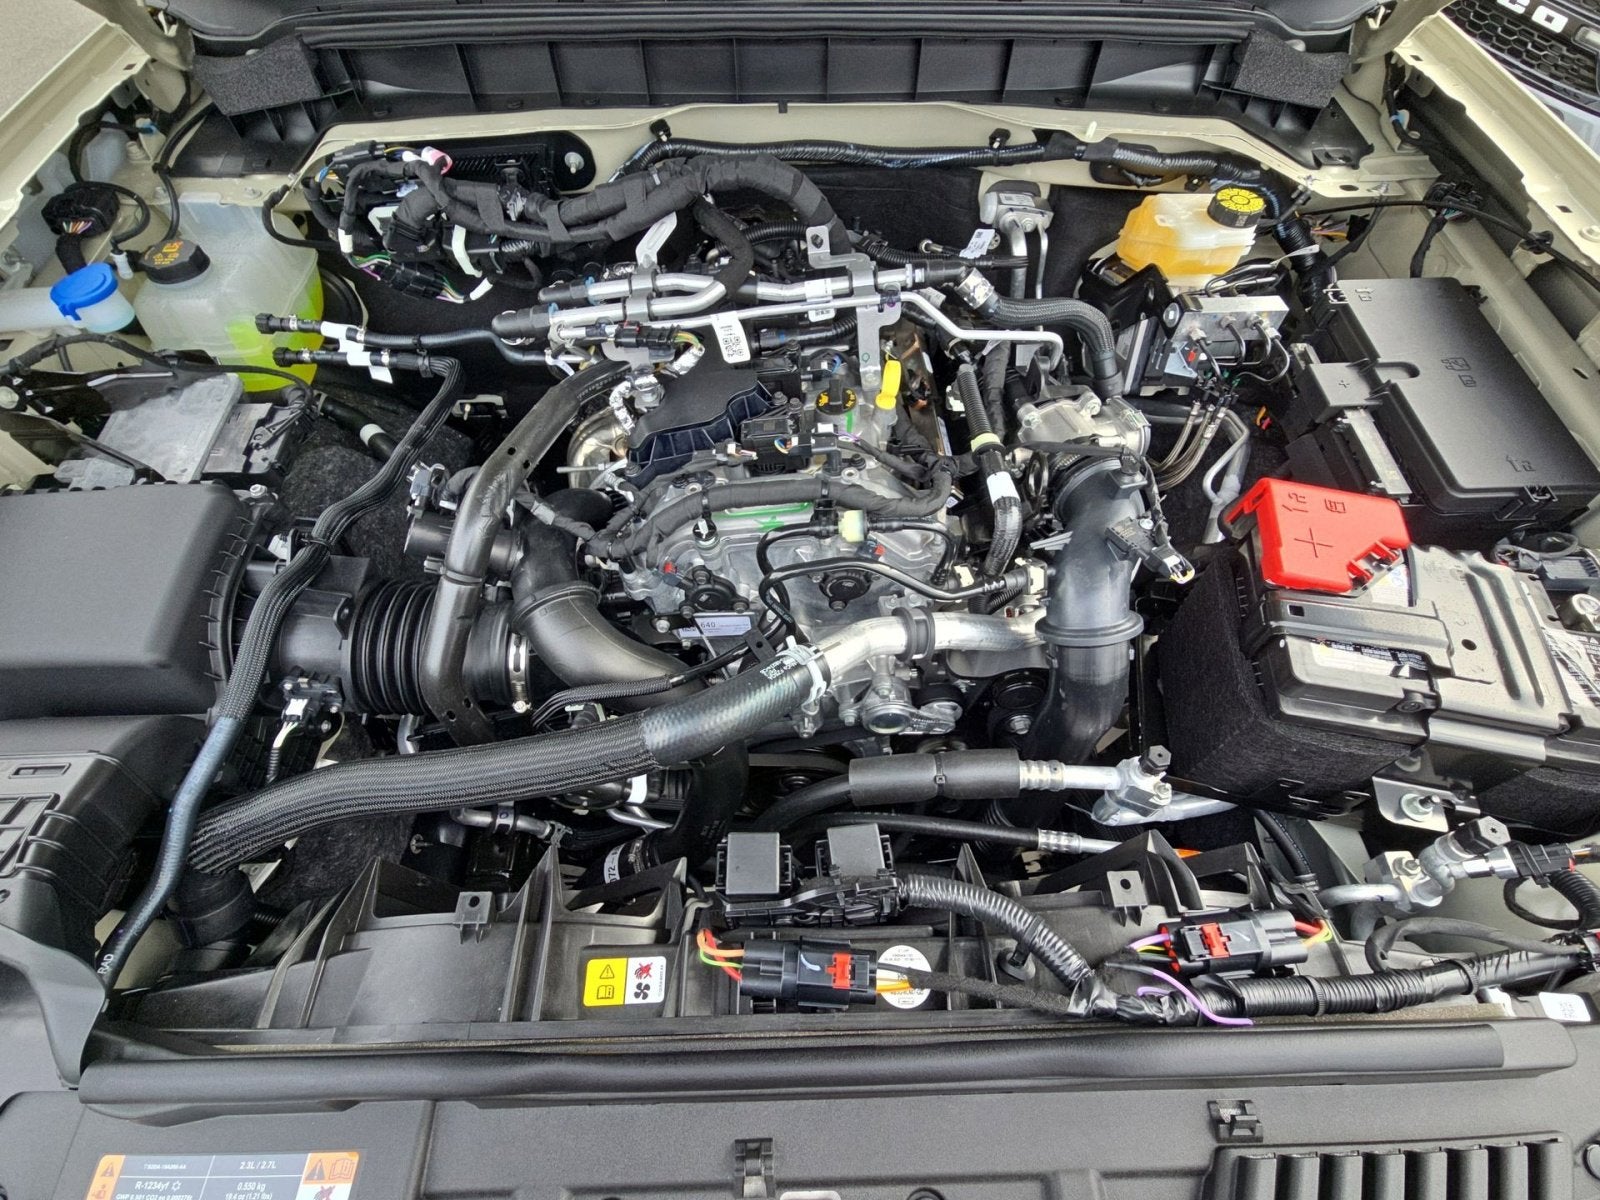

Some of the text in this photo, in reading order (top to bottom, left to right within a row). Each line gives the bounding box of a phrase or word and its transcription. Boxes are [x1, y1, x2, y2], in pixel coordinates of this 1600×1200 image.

[240, 1161, 255, 1170] 2.3L
[261, 1161, 277, 1169] 2.7L
[134, 1180, 170, 1192] R-1234yf
[237, 1182, 266, 1192] 0.550 kg
